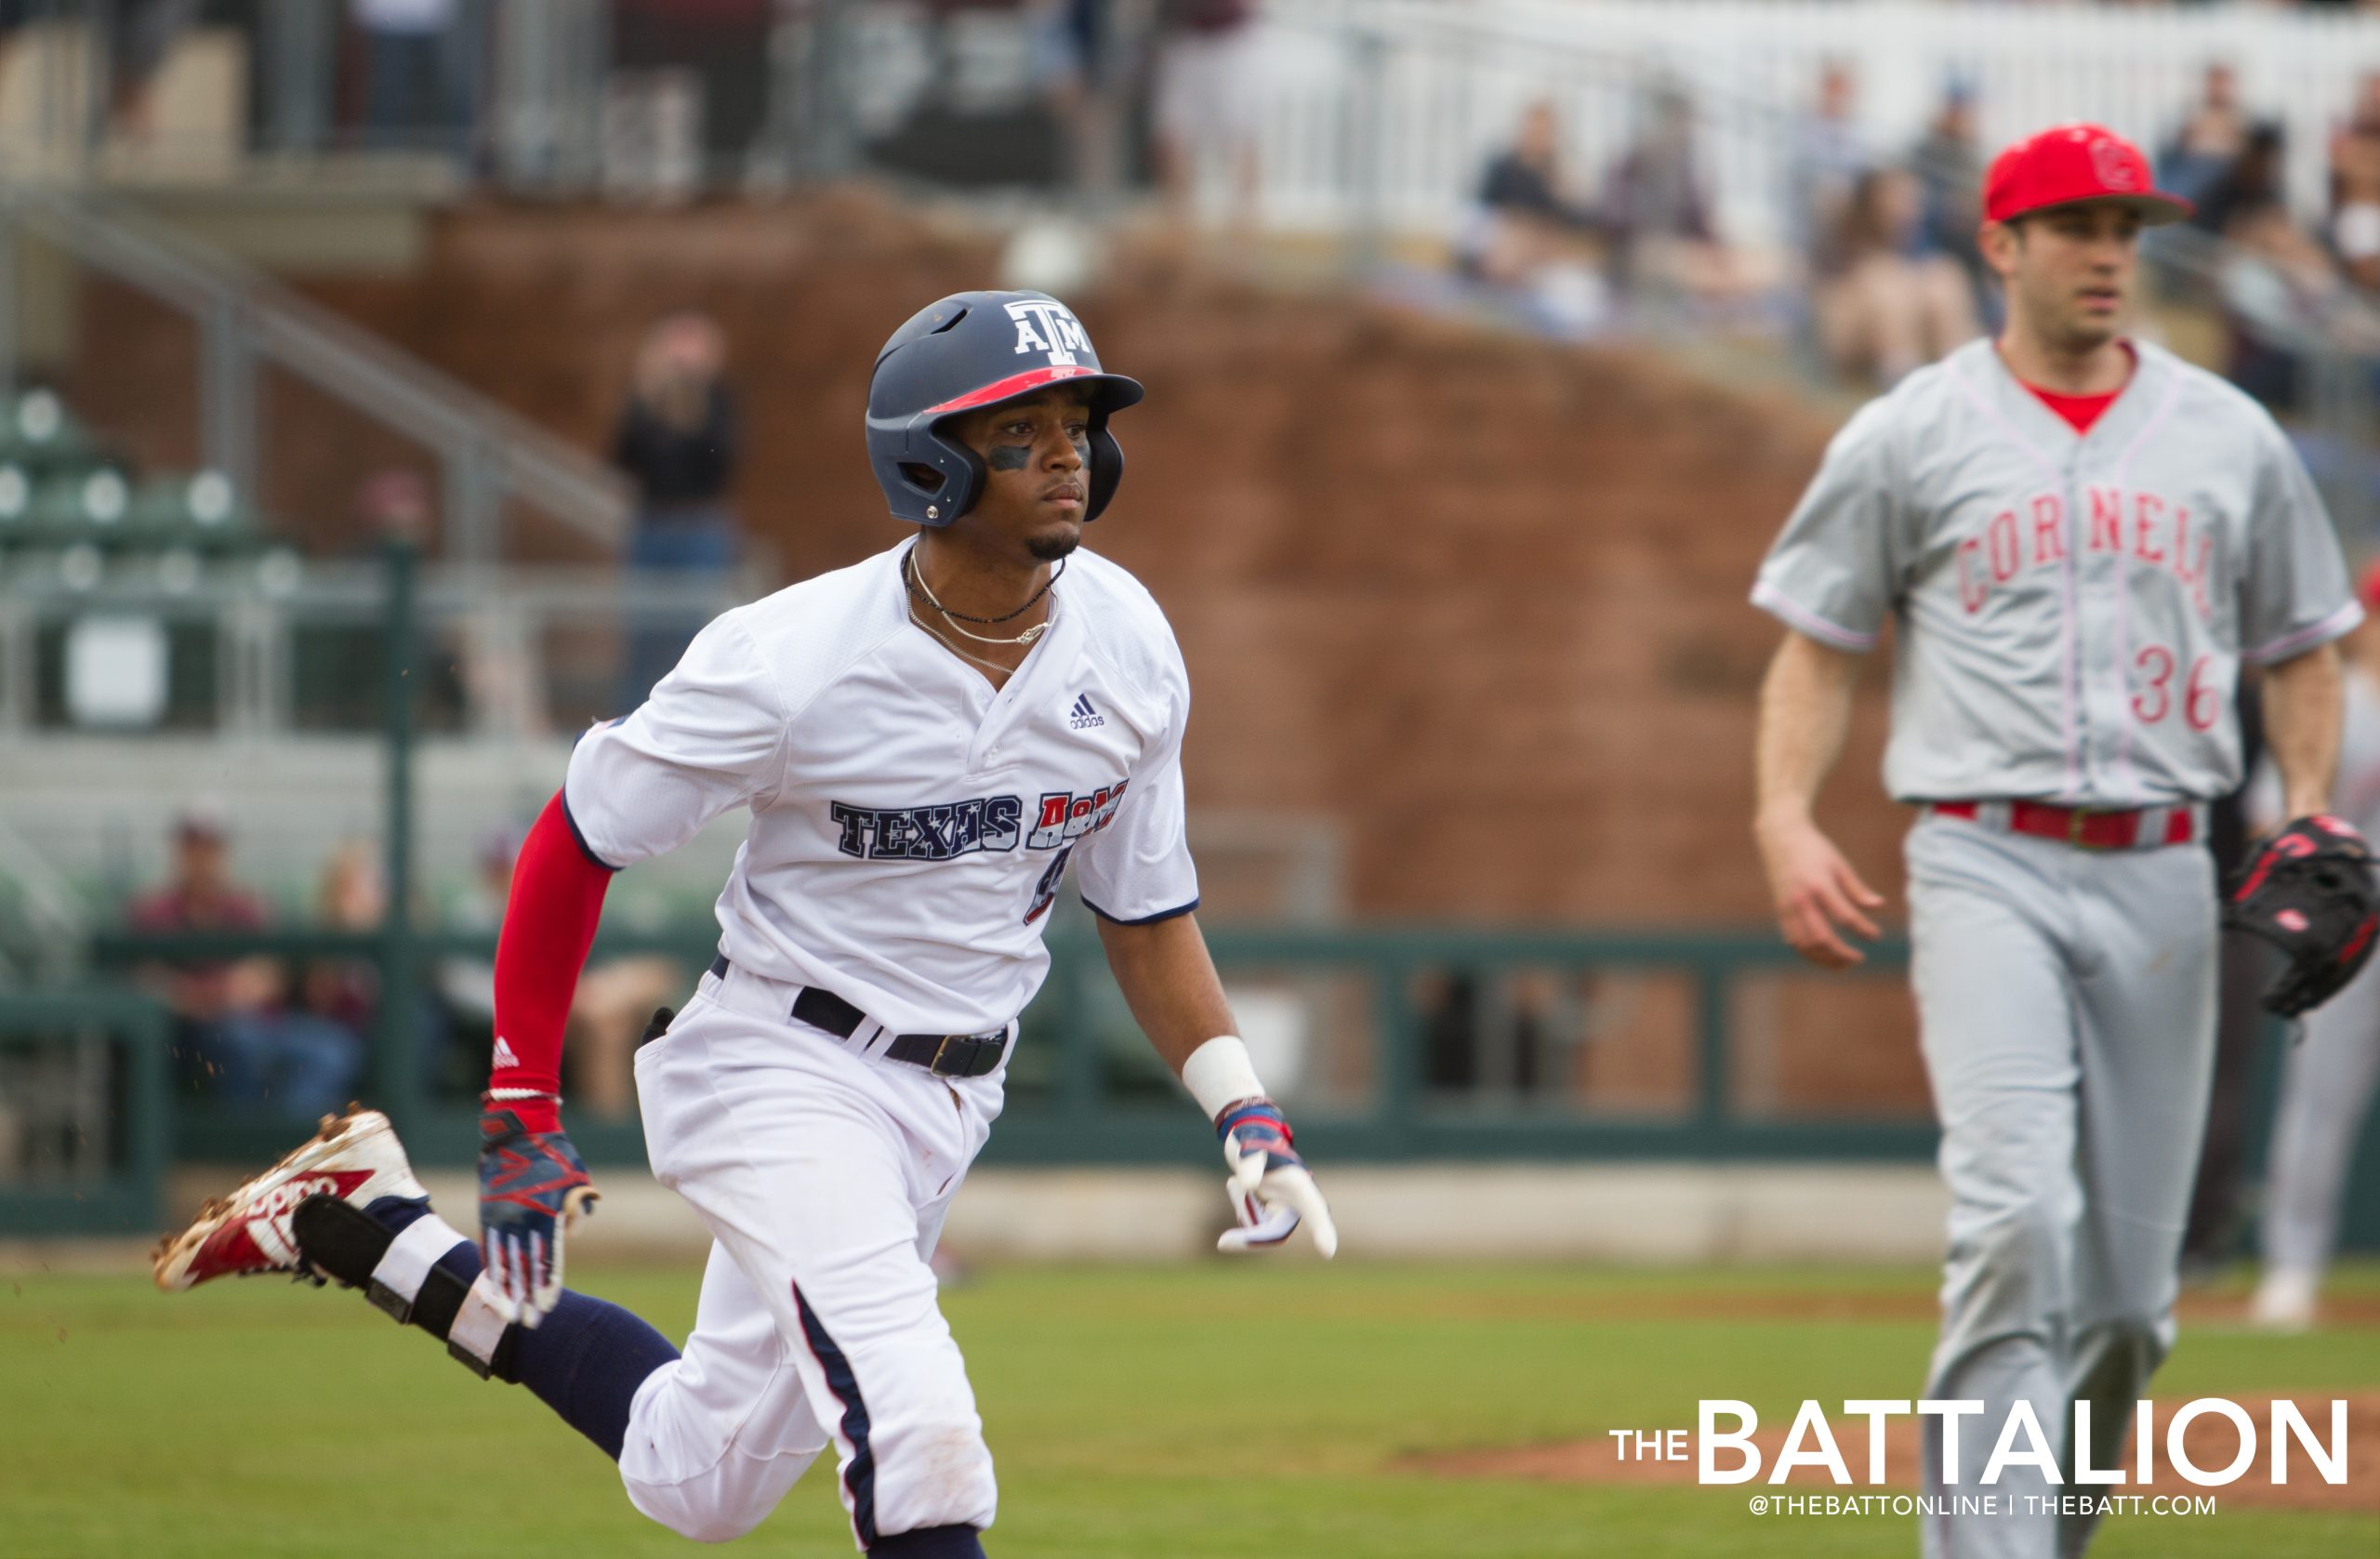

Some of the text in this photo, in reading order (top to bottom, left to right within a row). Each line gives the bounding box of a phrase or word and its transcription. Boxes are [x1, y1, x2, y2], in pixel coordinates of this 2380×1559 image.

[1070, 714, 1104, 730] adidas
[2131, 644, 2221, 733] 36
[830, 777, 1130, 862] TEXAS A&M
